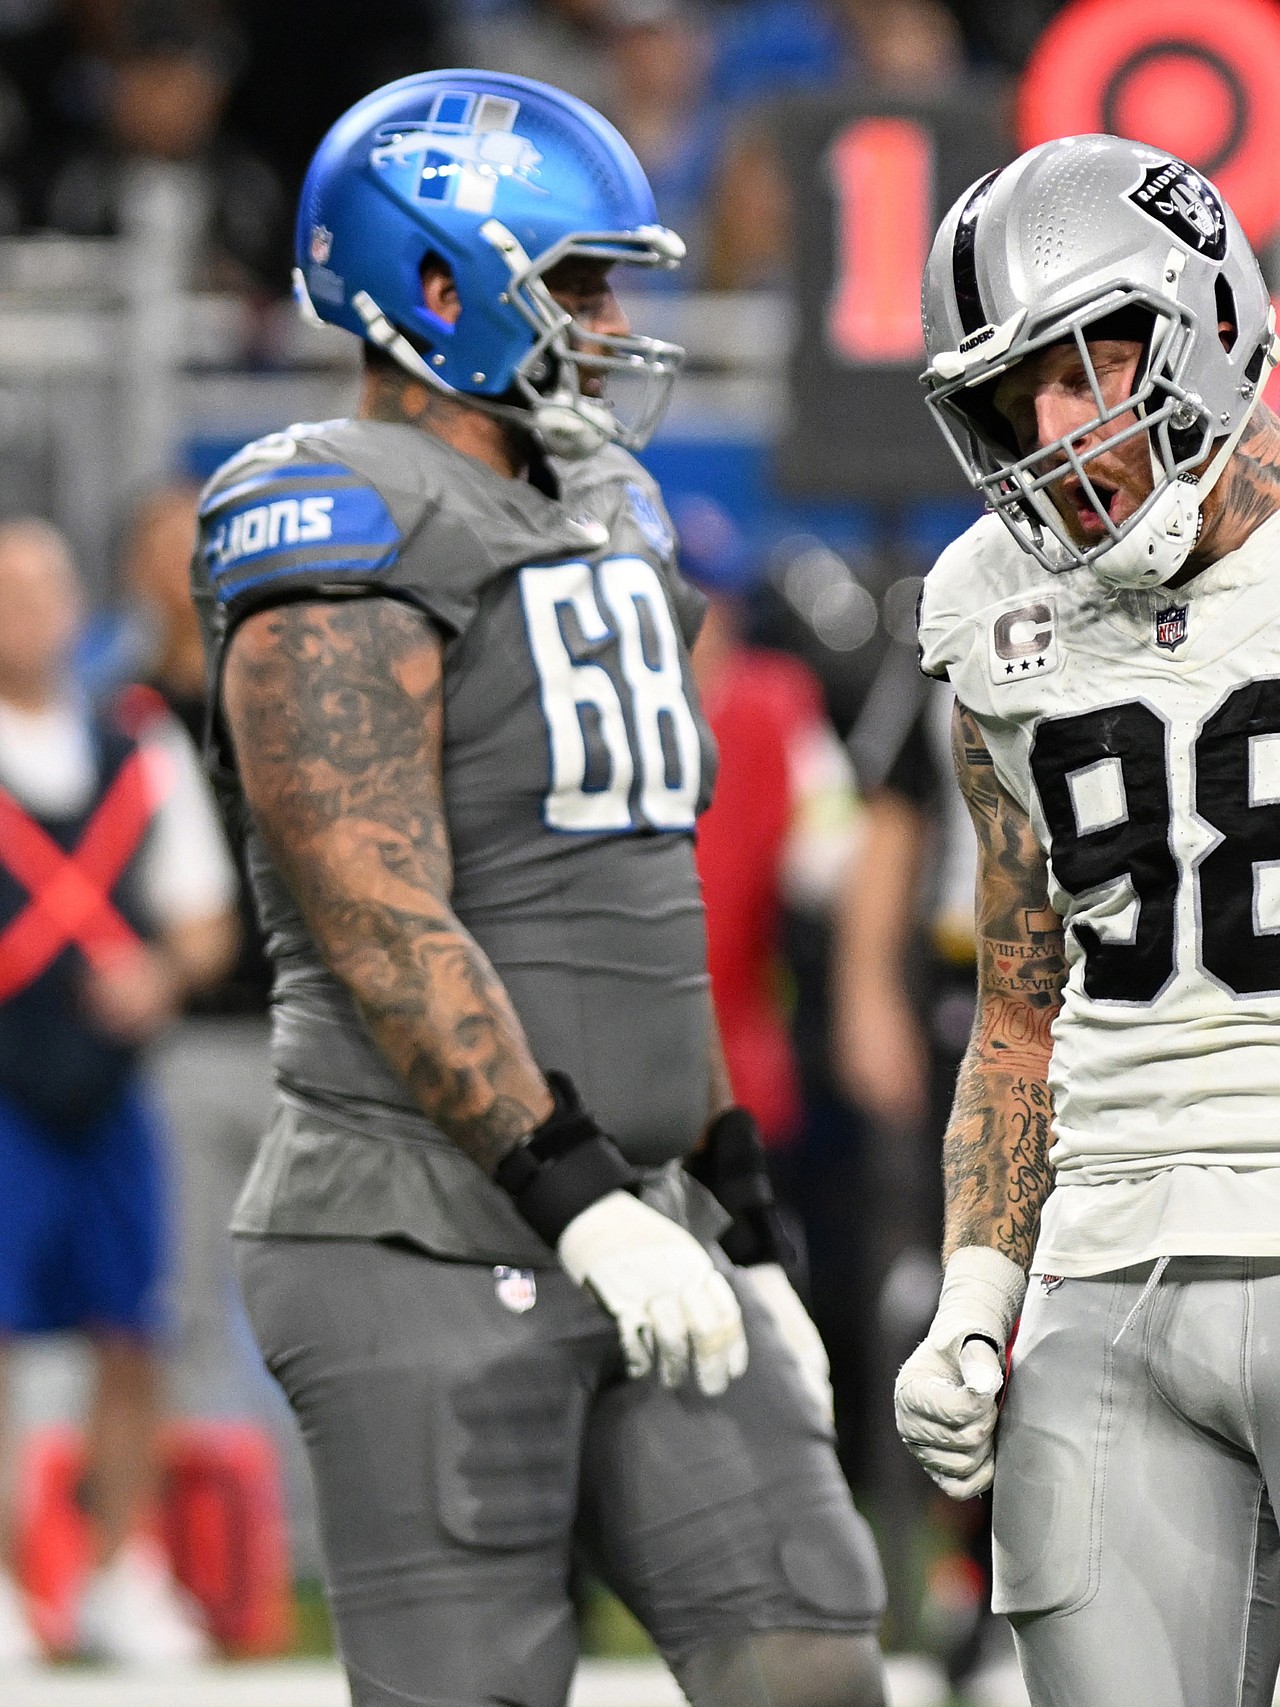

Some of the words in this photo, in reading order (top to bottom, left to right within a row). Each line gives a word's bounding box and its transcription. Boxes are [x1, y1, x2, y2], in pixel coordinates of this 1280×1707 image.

[959, 327, 995, 354] RAIDERS
[994, 603, 1053, 660] C
[1159, 621, 1183, 642] NFL
[518, 553, 700, 834] 68
